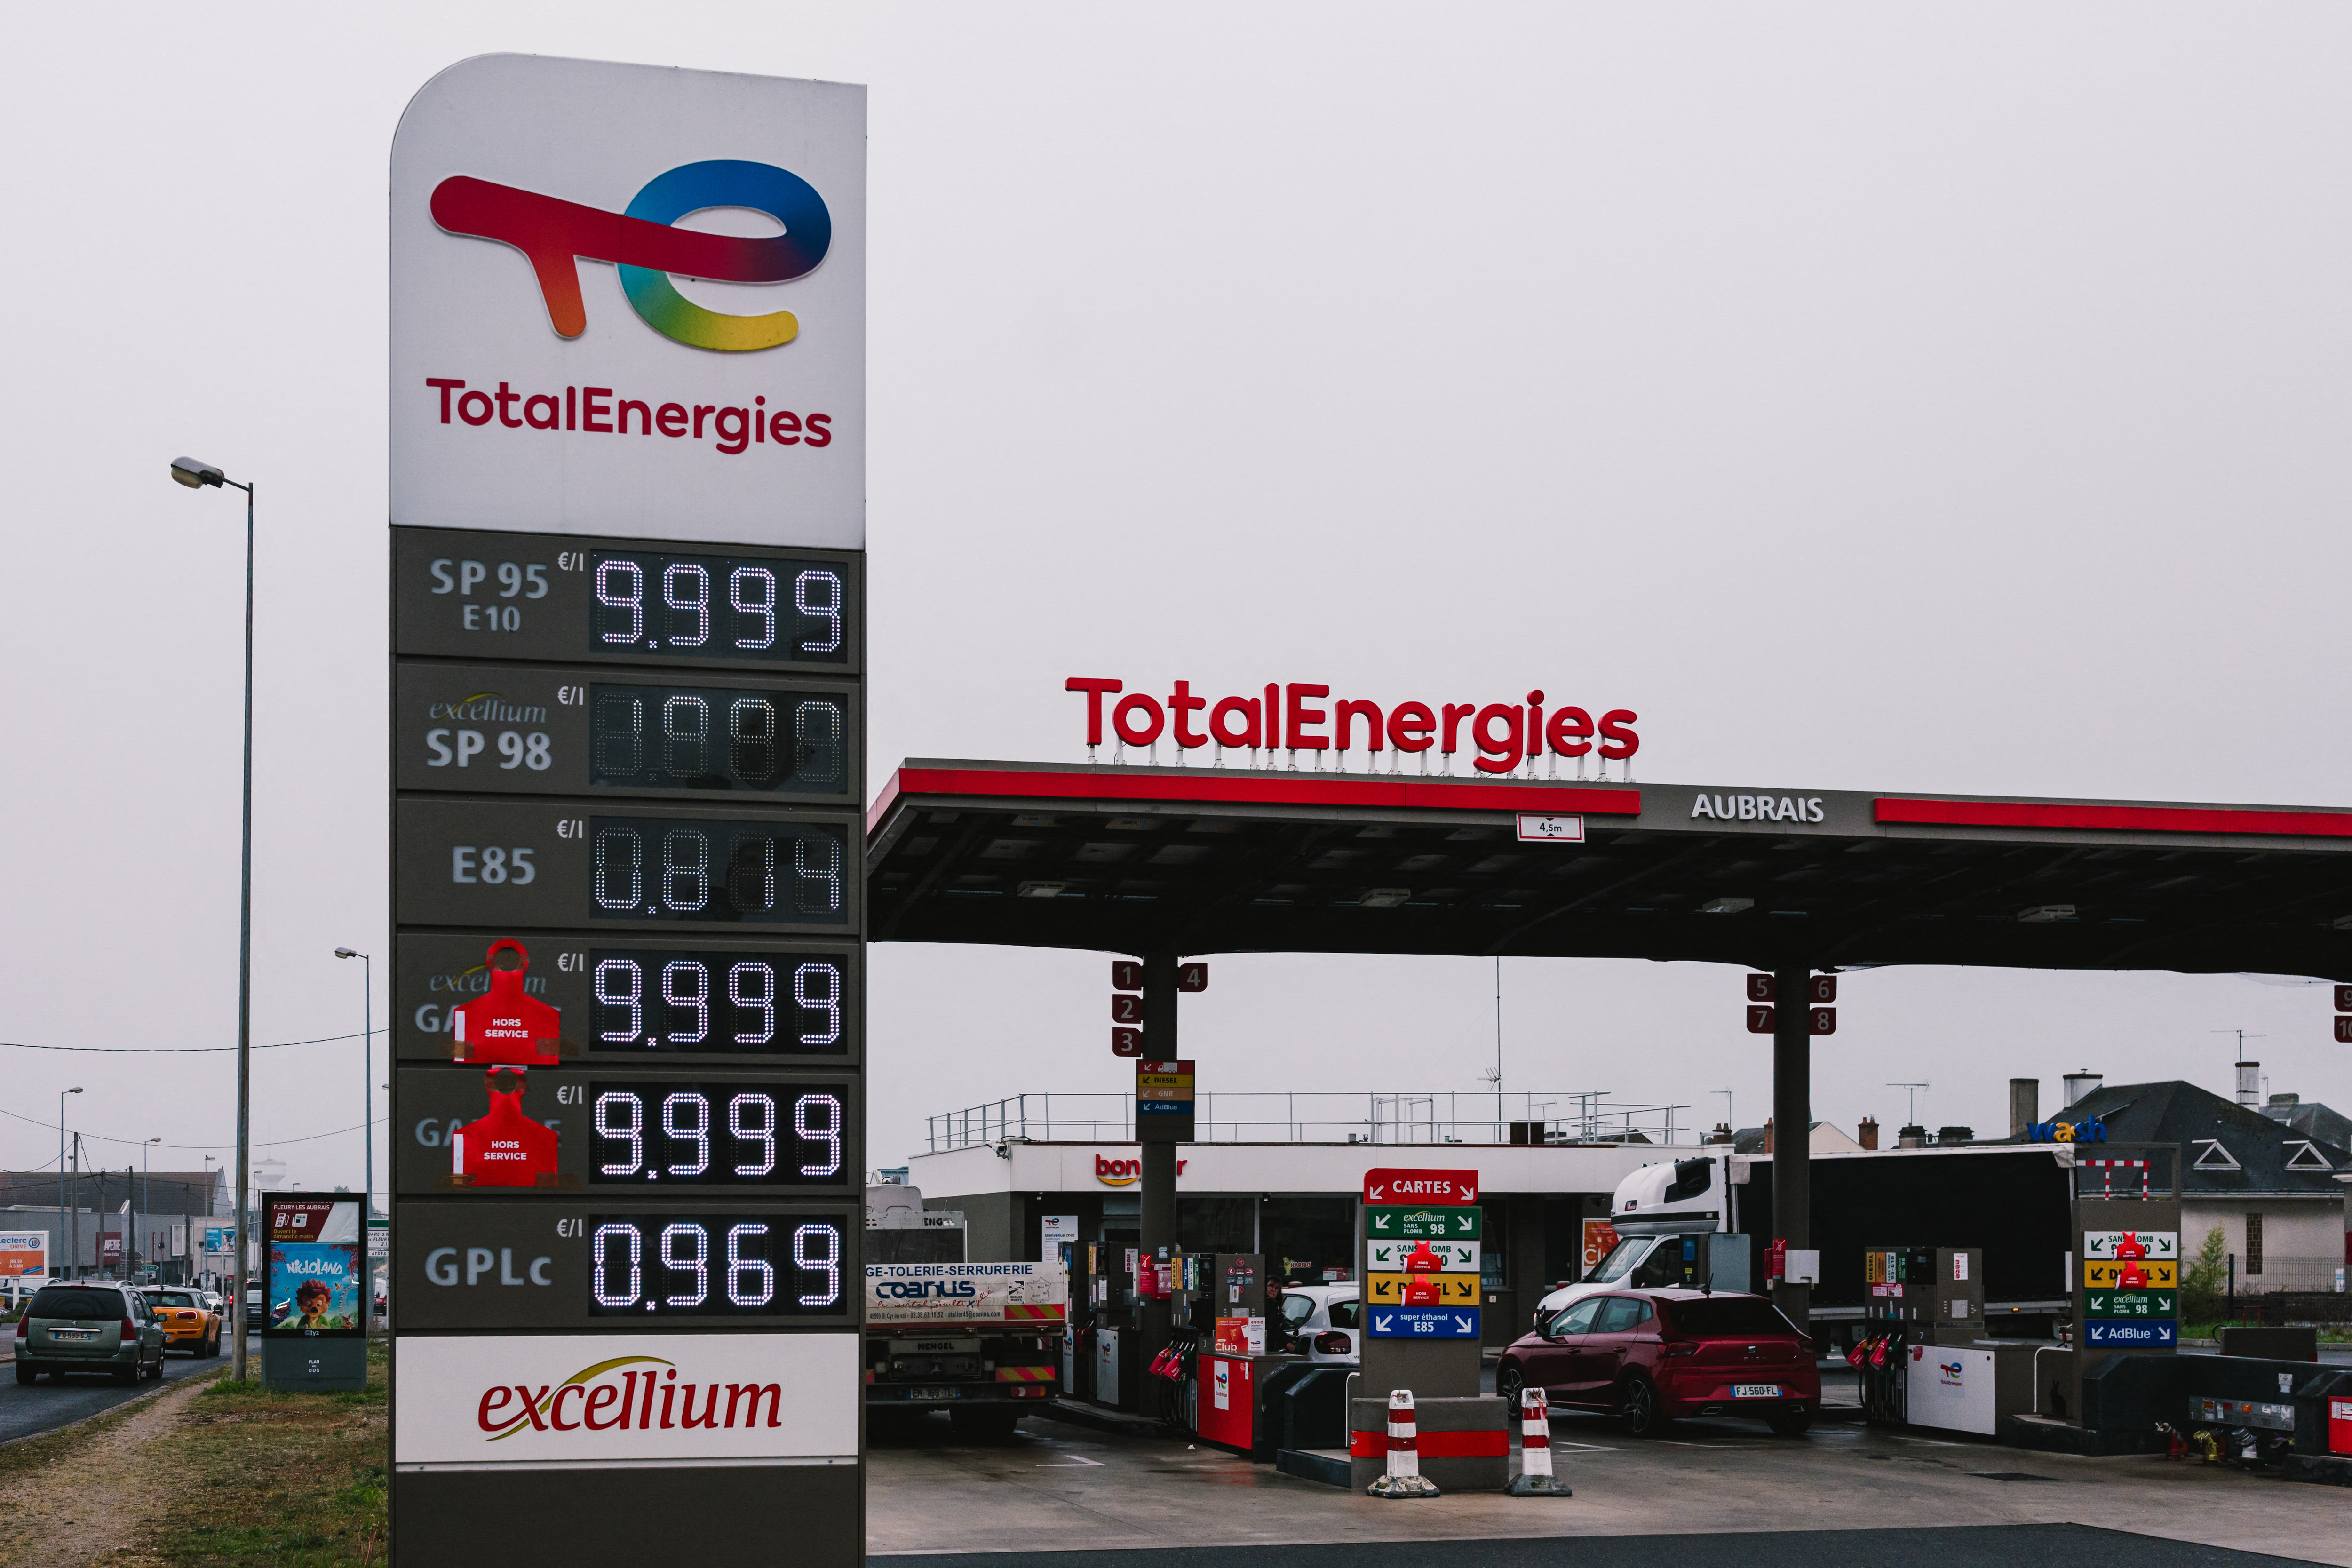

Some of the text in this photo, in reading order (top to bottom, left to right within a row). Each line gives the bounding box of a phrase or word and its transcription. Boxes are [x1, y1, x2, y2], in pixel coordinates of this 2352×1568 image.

[426, 378, 832, 454] TotalEnergies
[430, 558, 549, 599] SP 95
[596, 560, 841, 652] 9.999
[463, 605, 521, 632] E10
[430, 693, 547, 724] excellium
[1065, 677, 1639, 774] TotalEnergies
[426, 729, 485, 768] SP
[497, 732, 552, 771] 98
[1691, 794, 1825, 822] AUBRAIS
[453, 846, 536, 884] E85
[430, 970, 546, 994] excelm
[1122, 966, 1131, 985] 1
[1187, 968, 1200, 987] 4
[1757, 979, 1768, 997] 5
[1818, 980, 1829, 998] 6
[595, 959, 840, 1046] 9.999
[2344, 990, 2352, 1007] 9
[1121, 999, 1134, 1018] 2
[493, 1018, 521, 1027] HORS
[1756, 1011, 1767, 1028] 7
[1818, 1012, 1829, 1030] 8
[485, 1029, 529, 1038] SERVICE
[1121, 1033, 1133, 1051] 3
[596, 1092, 841, 1180] 9.999
[2026, 1114, 2106, 1143] wash
[1095, 1153, 1188, 1176] bonr
[1392, 1180, 1451, 1194] CARTES
[1403, 1213, 1445, 1222] excellium
[1430, 1224, 1445, 1234] 98
[425, 1247, 553, 1286] GPLc
[594, 1224, 839, 1311] 0.969
[2114, 1295, 2148, 1303] excellium
[2136, 1305, 2148, 1314] 98
[1414, 1321, 1434, 1332] E85
[2108, 1328, 2151, 1339] AdBlue
[1215, 1342, 1238, 1351] Club
[477, 1368, 782, 1432] excellium
[1736, 1386, 1777, 1395] FJ-560-FL
